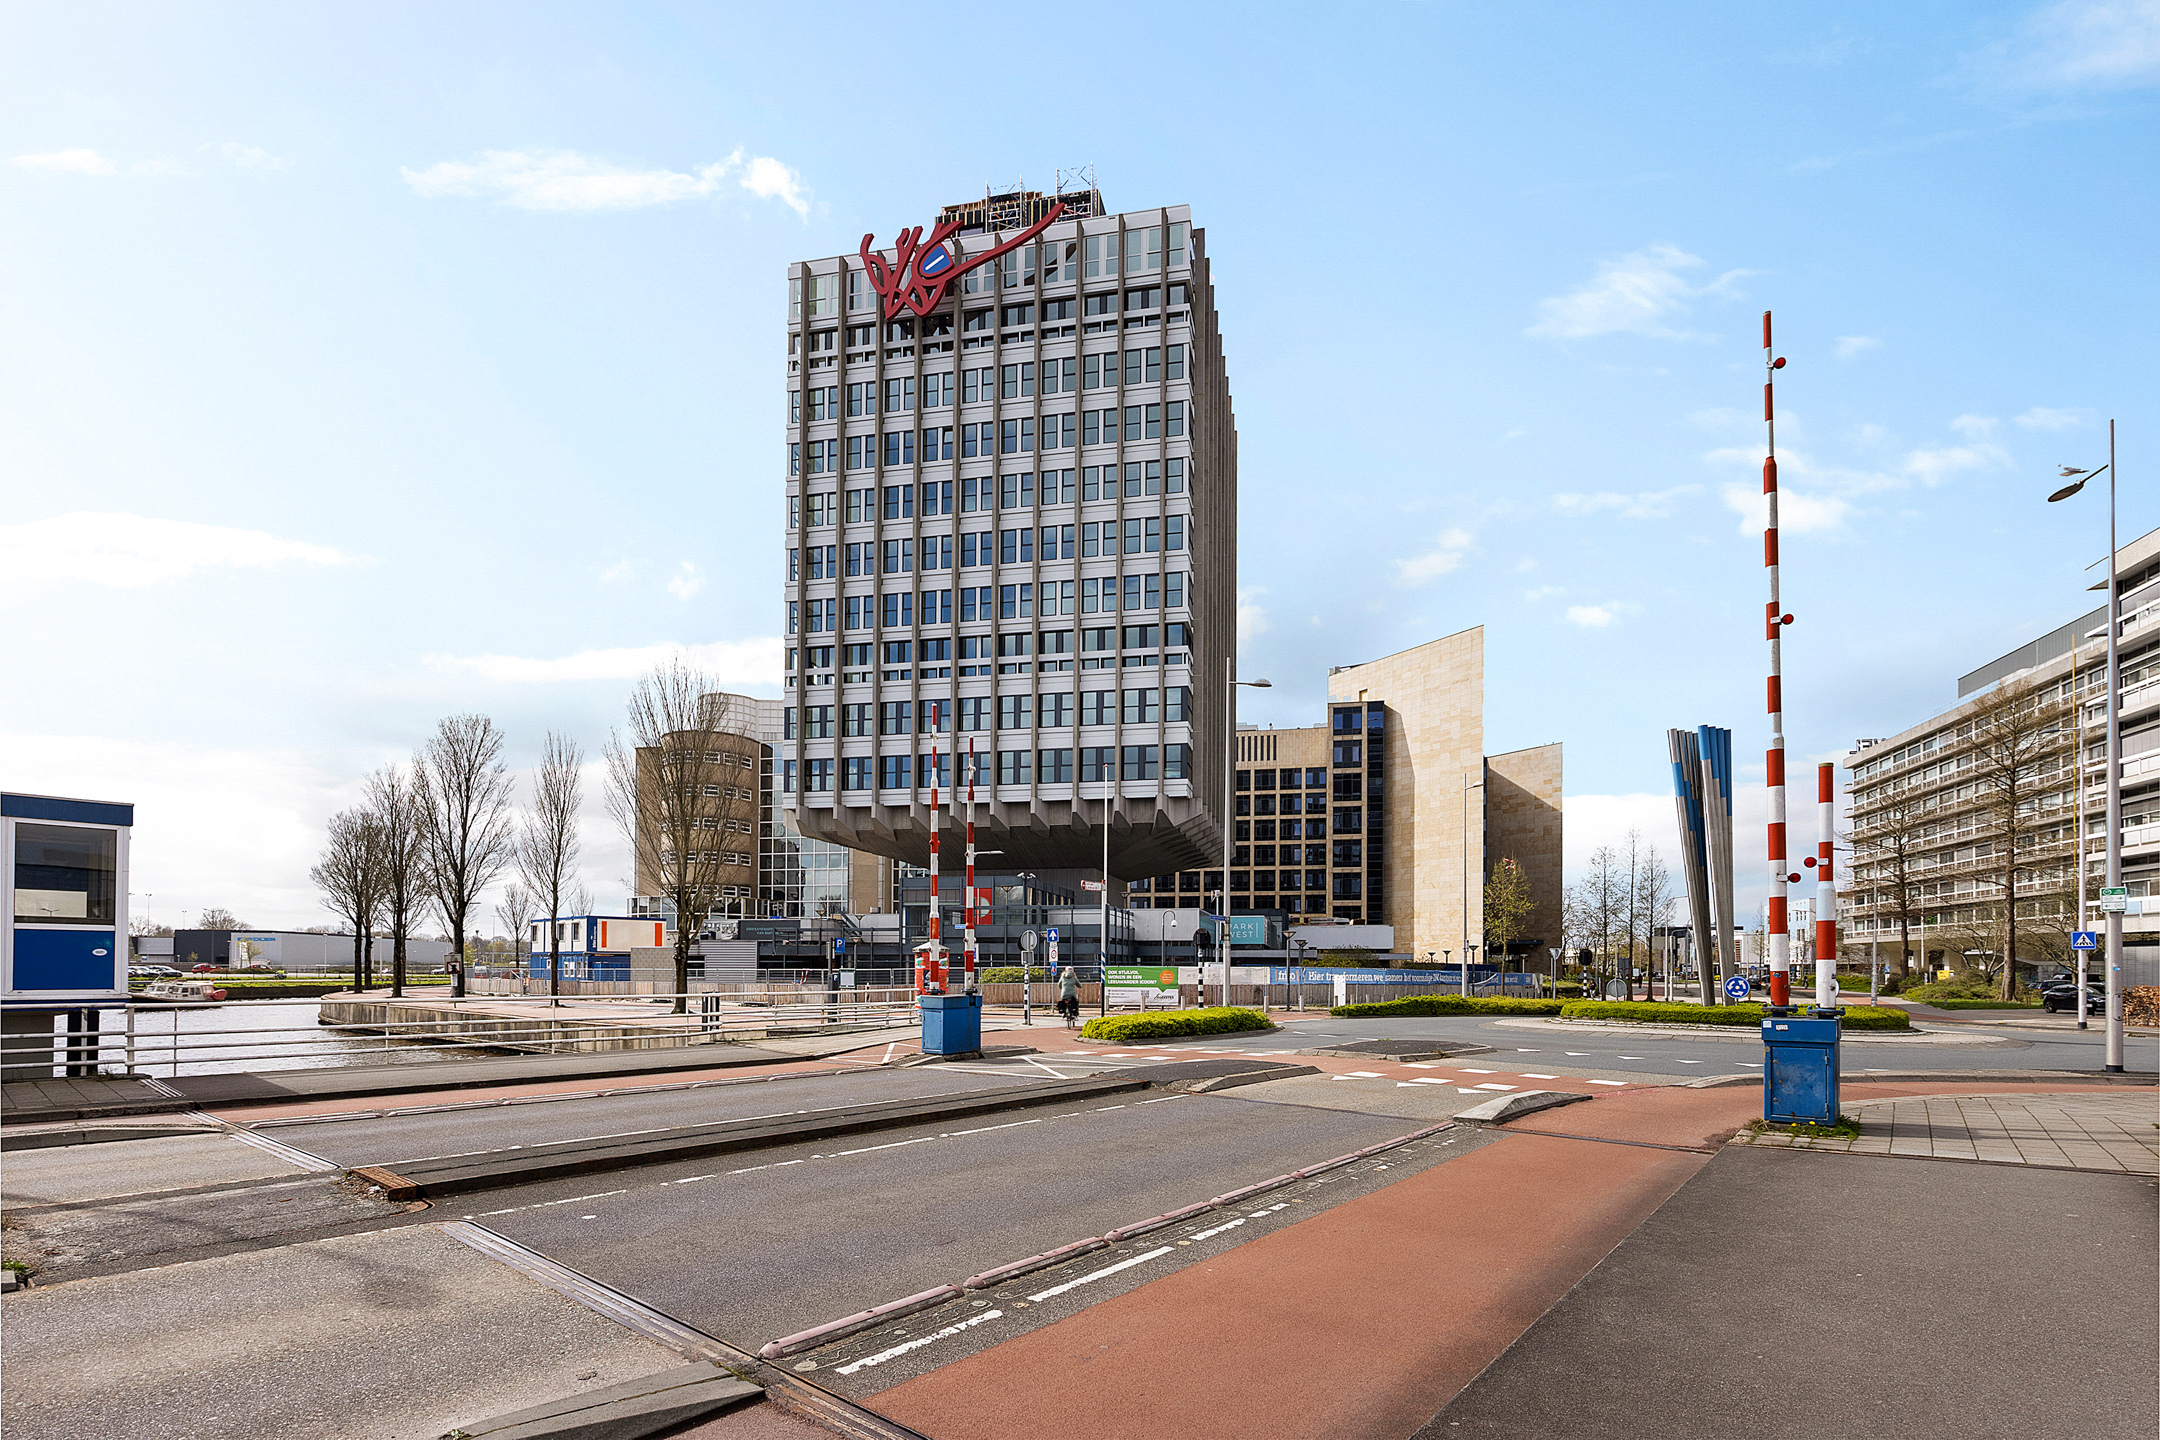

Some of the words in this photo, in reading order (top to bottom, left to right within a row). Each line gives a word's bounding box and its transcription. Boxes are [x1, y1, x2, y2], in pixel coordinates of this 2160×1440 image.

[1277, 970, 1296, 980] frio
[1308, 971, 1324, 981] Hier
[1326, 971, 1372, 981] traformeren
